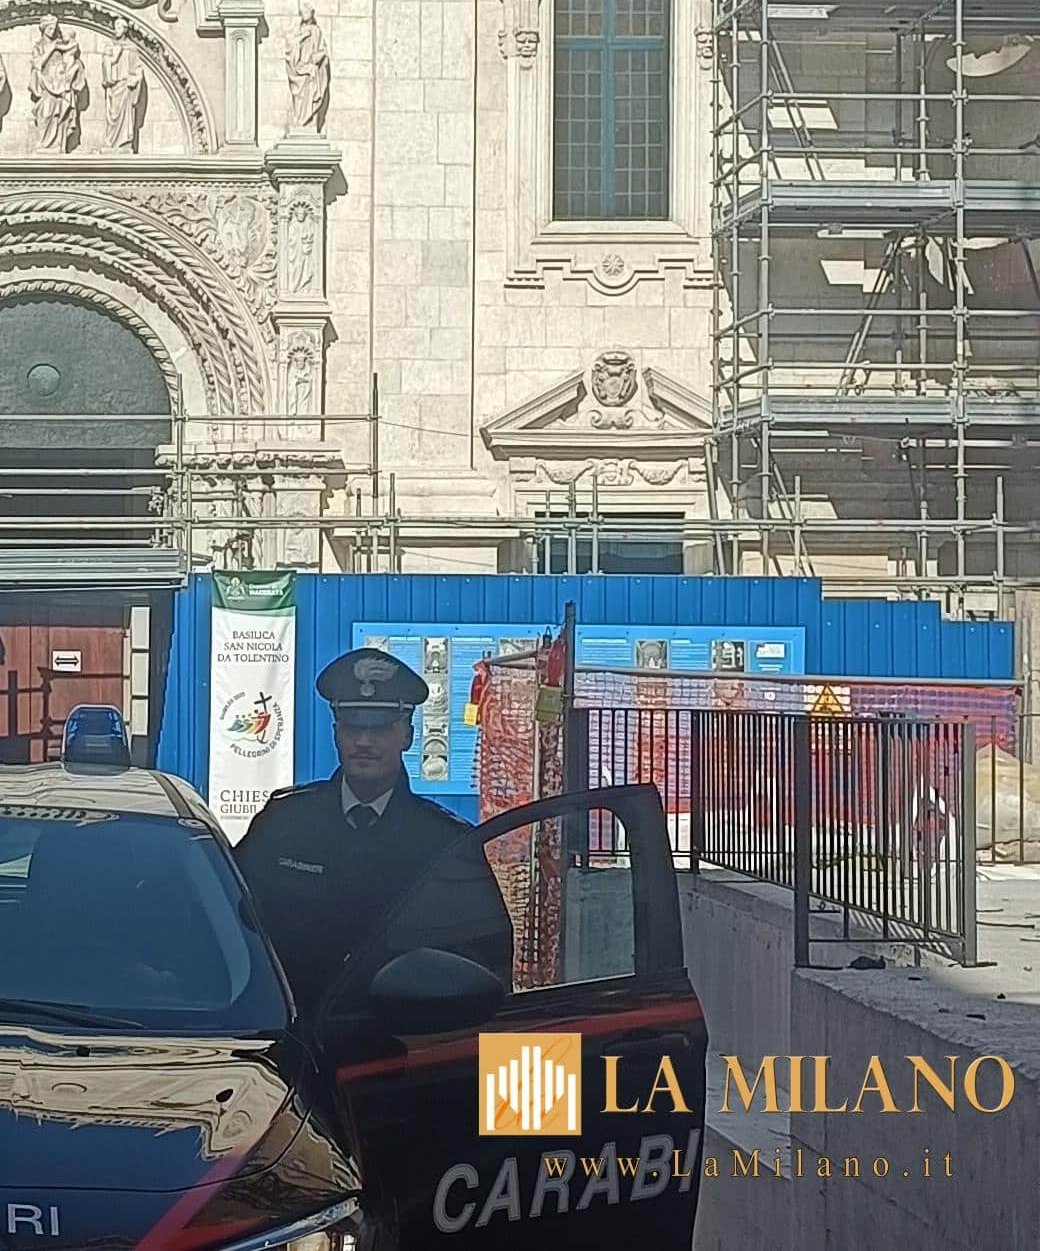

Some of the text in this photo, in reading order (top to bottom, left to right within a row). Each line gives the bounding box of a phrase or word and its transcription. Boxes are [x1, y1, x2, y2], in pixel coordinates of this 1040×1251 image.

[232, 630, 276, 640] BASILICA
[223, 641, 283, 652] SAN NICOLA
[217, 653, 290, 663] DA TOLENTINO
[220, 789, 269, 803] CHIES
[432, 1128, 702, 1234] CARABI
